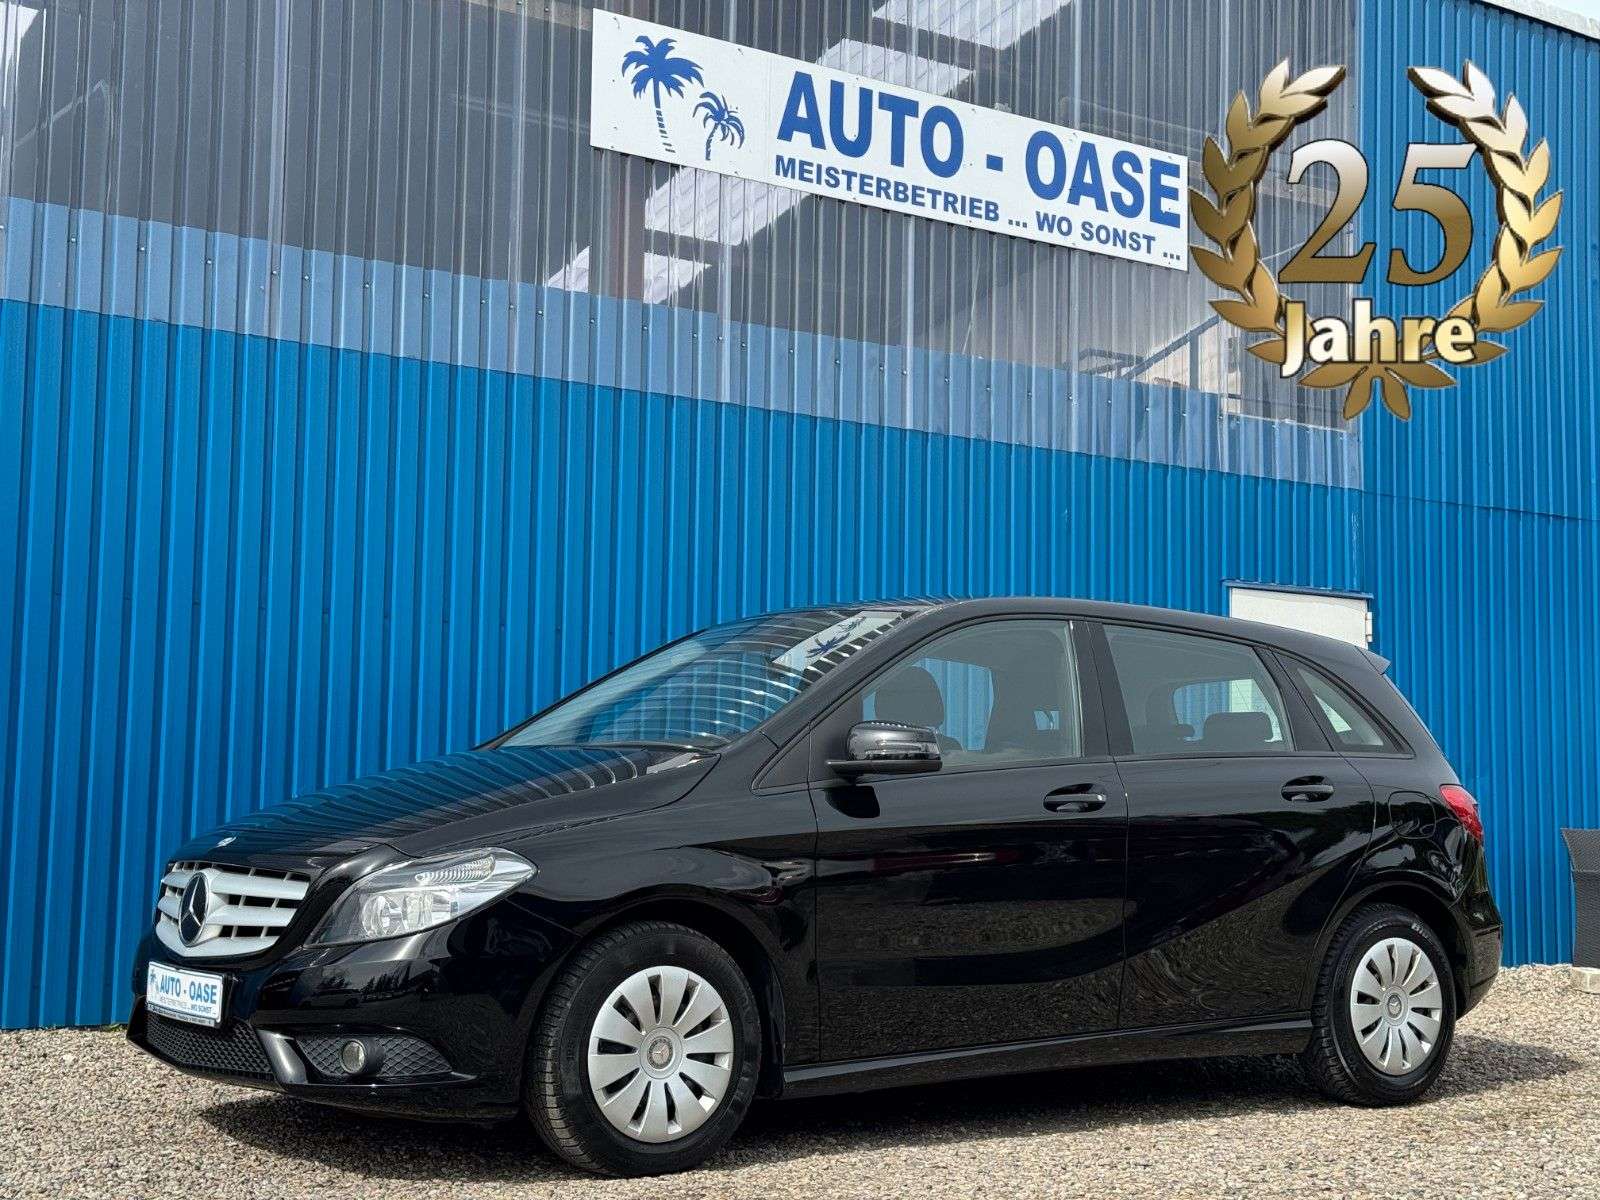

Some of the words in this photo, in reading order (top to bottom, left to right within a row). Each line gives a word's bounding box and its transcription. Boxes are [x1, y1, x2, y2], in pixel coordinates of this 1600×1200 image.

[777, 71, 964, 178] AUTO
[986, 154, 1003, 171] -
[1024, 131, 1181, 229] OASE
[775, 155, 999, 222] MEISTERBETRIEB
[1035, 210, 1072, 237] WO
[1080, 222, 1156, 255] SONST
[160, 974, 181, 997] AUTO
[190, 981, 217, 1004] OASE
